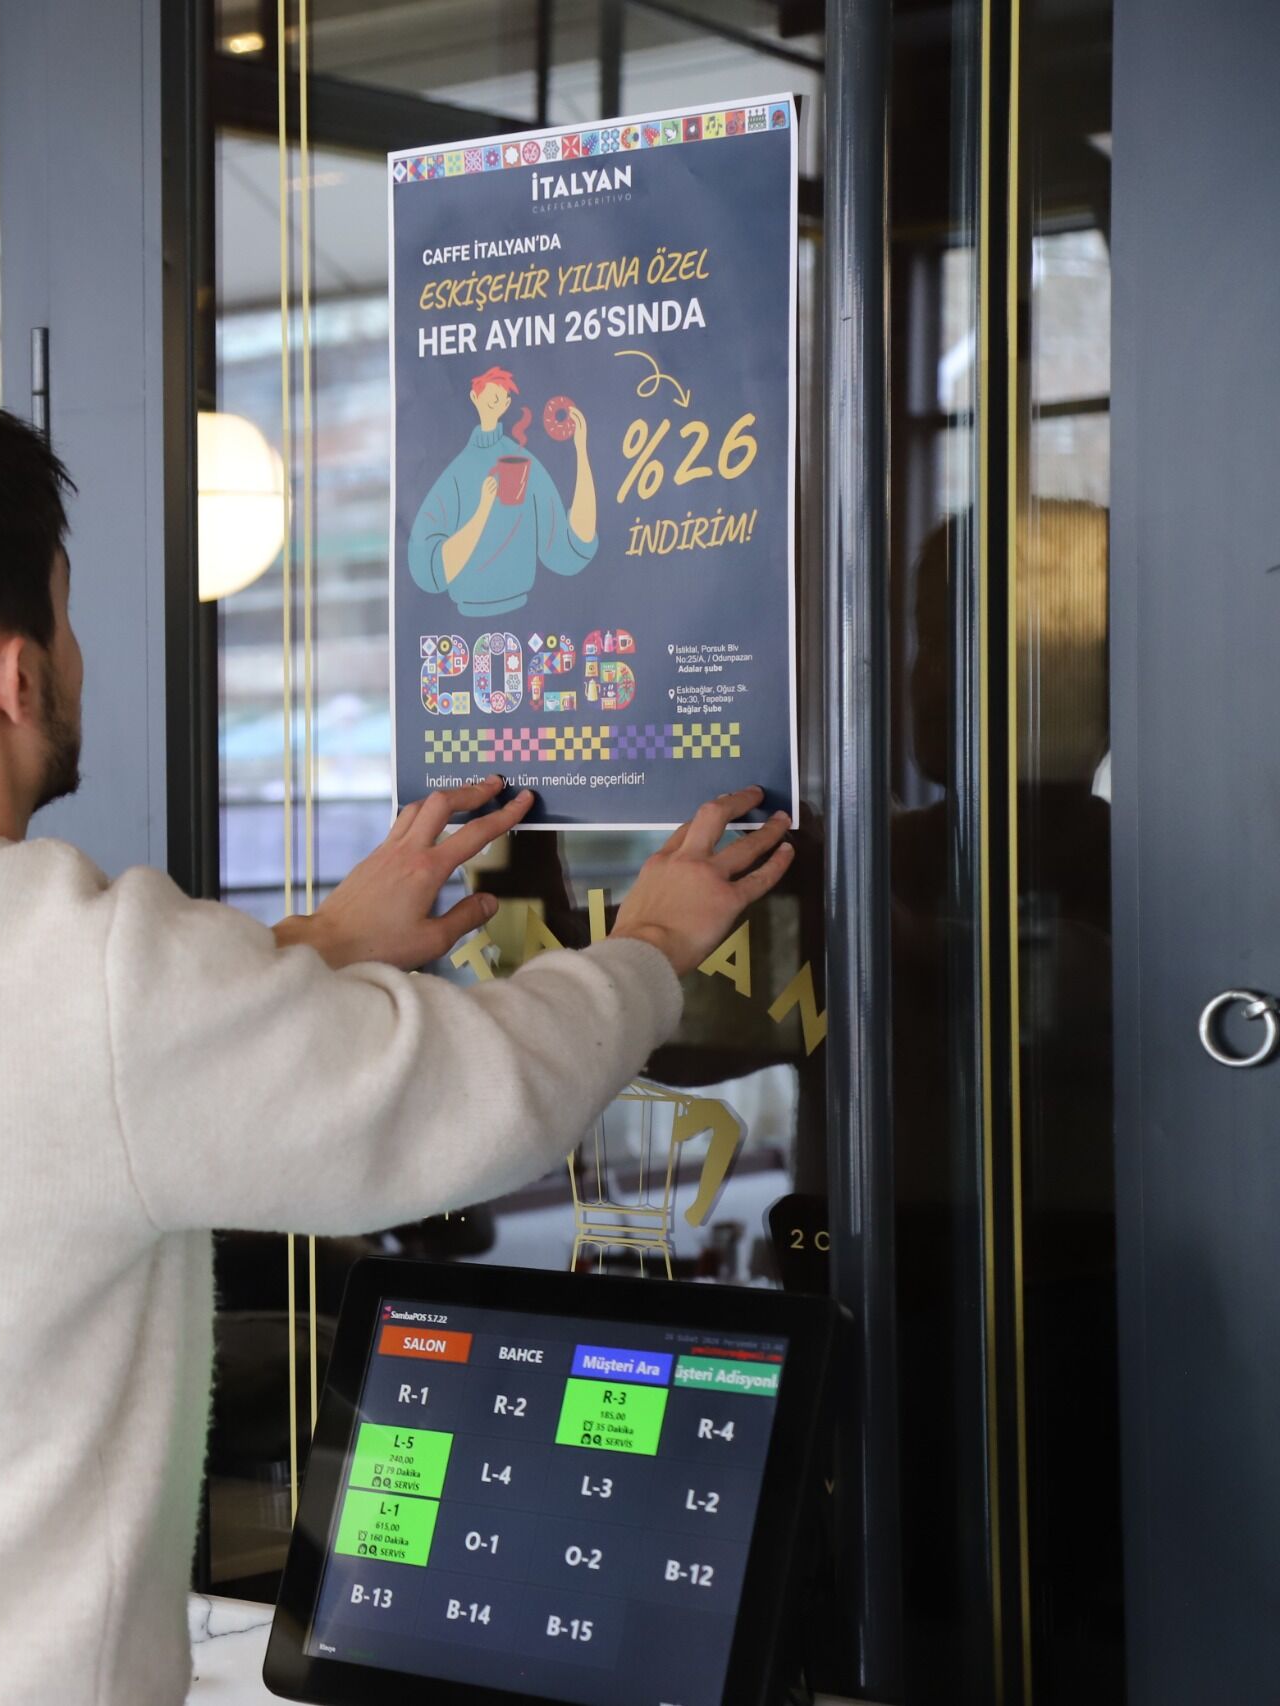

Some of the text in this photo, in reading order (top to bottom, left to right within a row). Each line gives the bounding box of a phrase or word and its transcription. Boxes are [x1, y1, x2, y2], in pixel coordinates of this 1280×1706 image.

[531, 165, 632, 201] İTALYAN
[422, 233, 562, 266] CAFFE İTALYAN'DA
[419, 246, 710, 312] ESKİŞEHİR YILINA ÖZEL
[418, 297, 707, 358] HER AYIN 26'SINDA
[616, 412, 758, 504] %26
[624, 507, 758, 556] İNDİRİM!
[701, 645, 726, 653] Porsuk
[727, 643, 739, 652] Blv
[420, 629, 636, 715] 2026
[678, 664, 723, 675] Adalar şube
[701, 694, 734, 705] Tepebaşı
[716, 684, 735, 695] Oğuz
[676, 705, 722, 715] Bağlar Şube
[426, 773, 463, 788] İndirim
[518, 774, 540, 787] tüm
[542, 772, 587, 787] menüde
[589, 771, 646, 791] geçerlidir!
[390, 1310, 448, 1324] SambaPOS 5.7.22
[403, 1336, 447, 1353] SALON
[498, 1346, 544, 1364] BAHCE
[582, 1354, 661, 1376] Müşteri Ara
[398, 1384, 429, 1405] R-1
[603, 1390, 627, 1405] R-3
[494, 1394, 527, 1417] R-2
[607, 1424, 634, 1435] Dakika
[697, 1417, 735, 1442] R-4
[393, 1434, 415, 1449] L-5
[605, 1437, 633, 1448] SERVİS
[396, 1467, 421, 1478] Dakika
[481, 1462, 512, 1485] L-4
[394, 1480, 420, 1491] SERVİS
[581, 1475, 613, 1498] L-3
[380, 1501, 400, 1517] L-1
[685, 1488, 720, 1513] L-2
[375, 1521, 400, 1532] 615,00
[384, 1534, 409, 1546] Dakika
[465, 1531, 499, 1554] O-1
[380, 1547, 406, 1559] SERVİS
[565, 1546, 602, 1570] O-2
[664, 1559, 714, 1587] B-12
[350, 1584, 393, 1608] B-13
[446, 1599, 491, 1625] B-14
[546, 1615, 594, 1641] B-15
